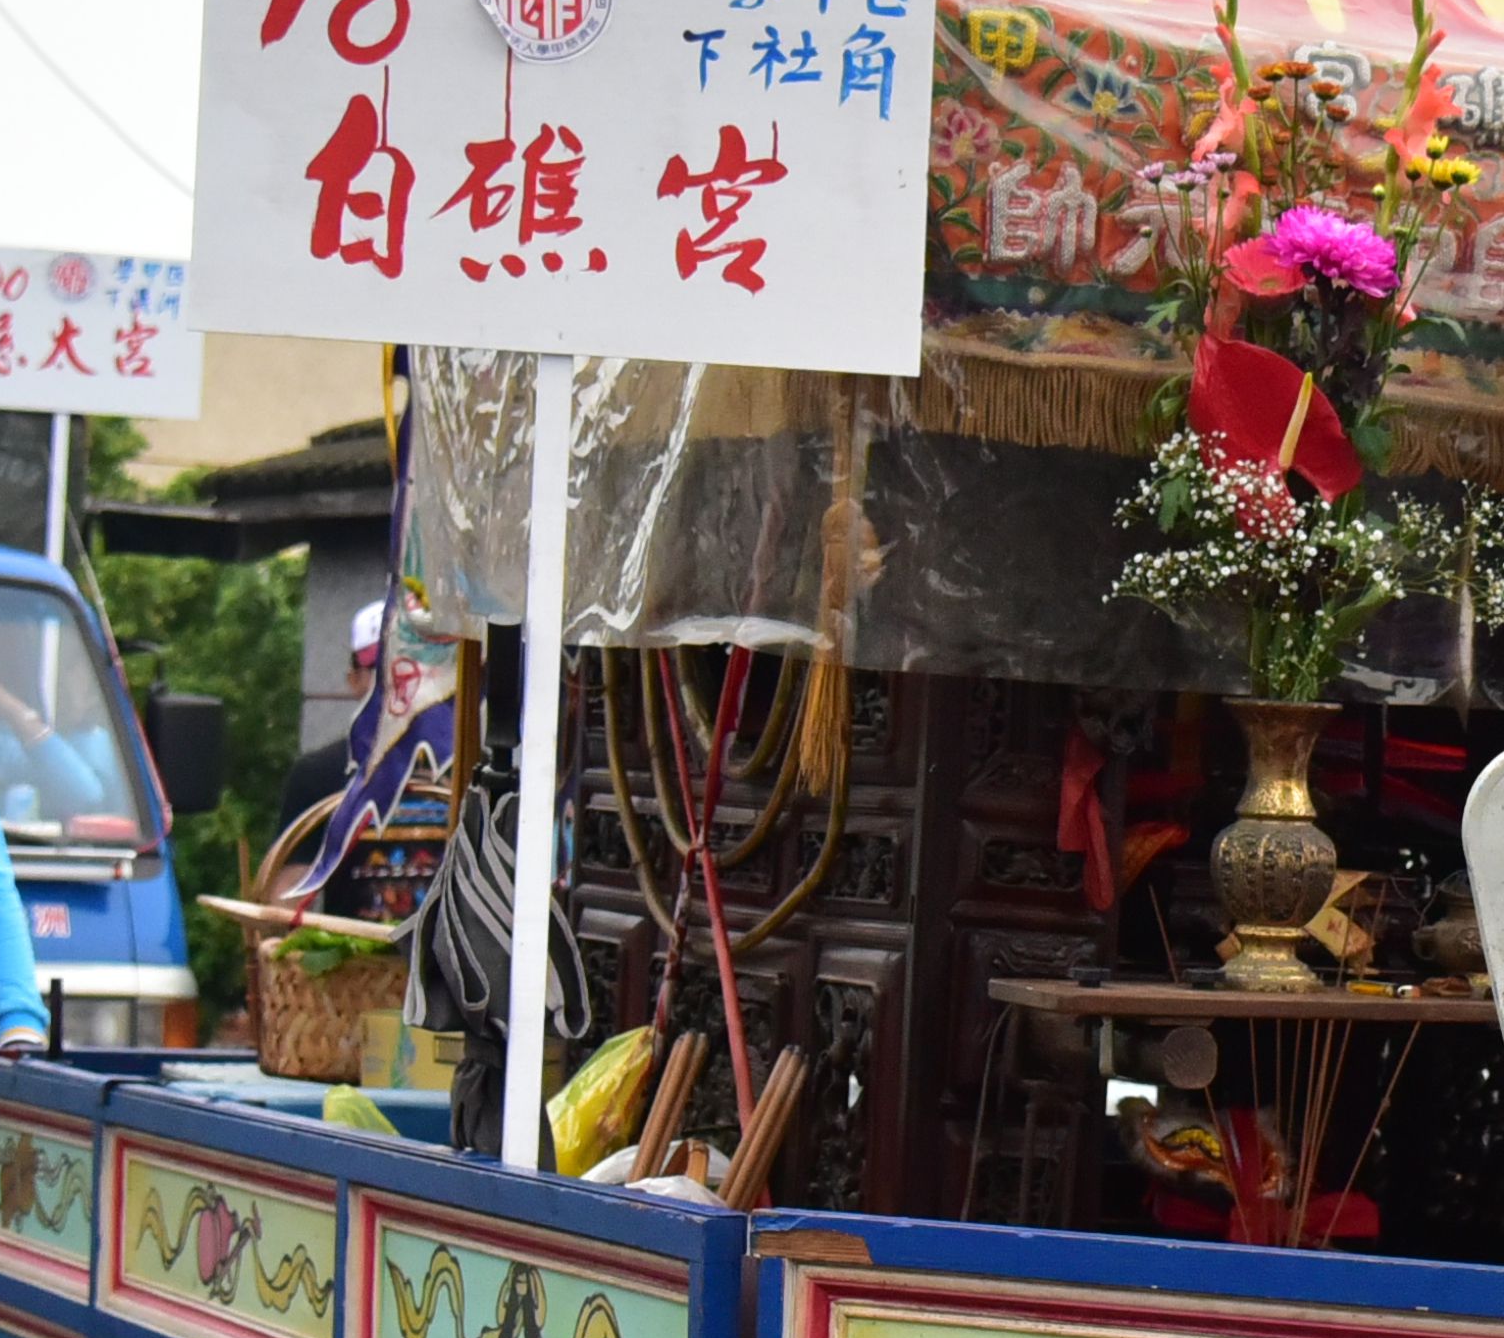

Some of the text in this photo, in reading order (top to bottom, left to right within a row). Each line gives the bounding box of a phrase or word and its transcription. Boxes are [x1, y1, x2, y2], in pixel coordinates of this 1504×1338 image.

[682, 23, 896, 120] 下社角
[305, 93, 789, 293] 白礁宮
